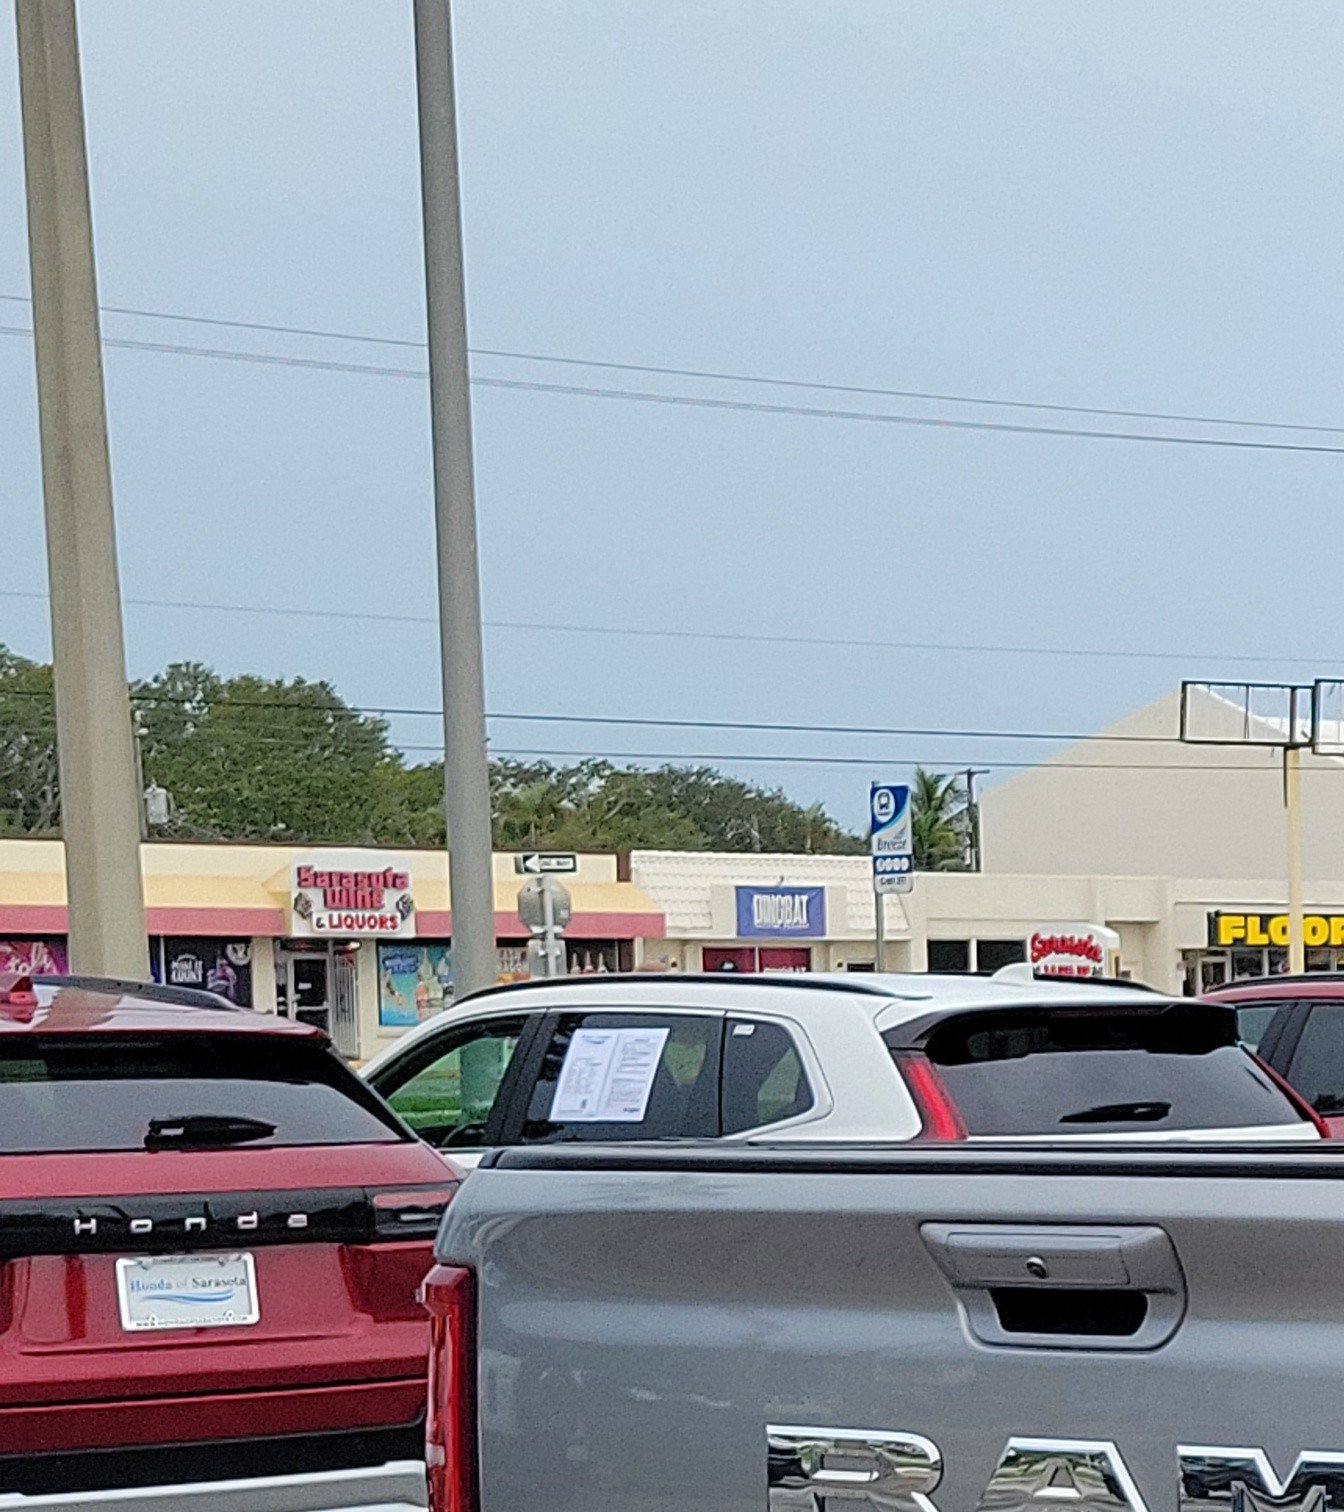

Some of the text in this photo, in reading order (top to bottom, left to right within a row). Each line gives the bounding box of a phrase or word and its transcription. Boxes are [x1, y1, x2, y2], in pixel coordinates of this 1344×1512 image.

[328, 913, 398, 930] LIQUORS
[130, 1279, 173, 1291] Honda
[192, 1276, 247, 1289] Sarasota
